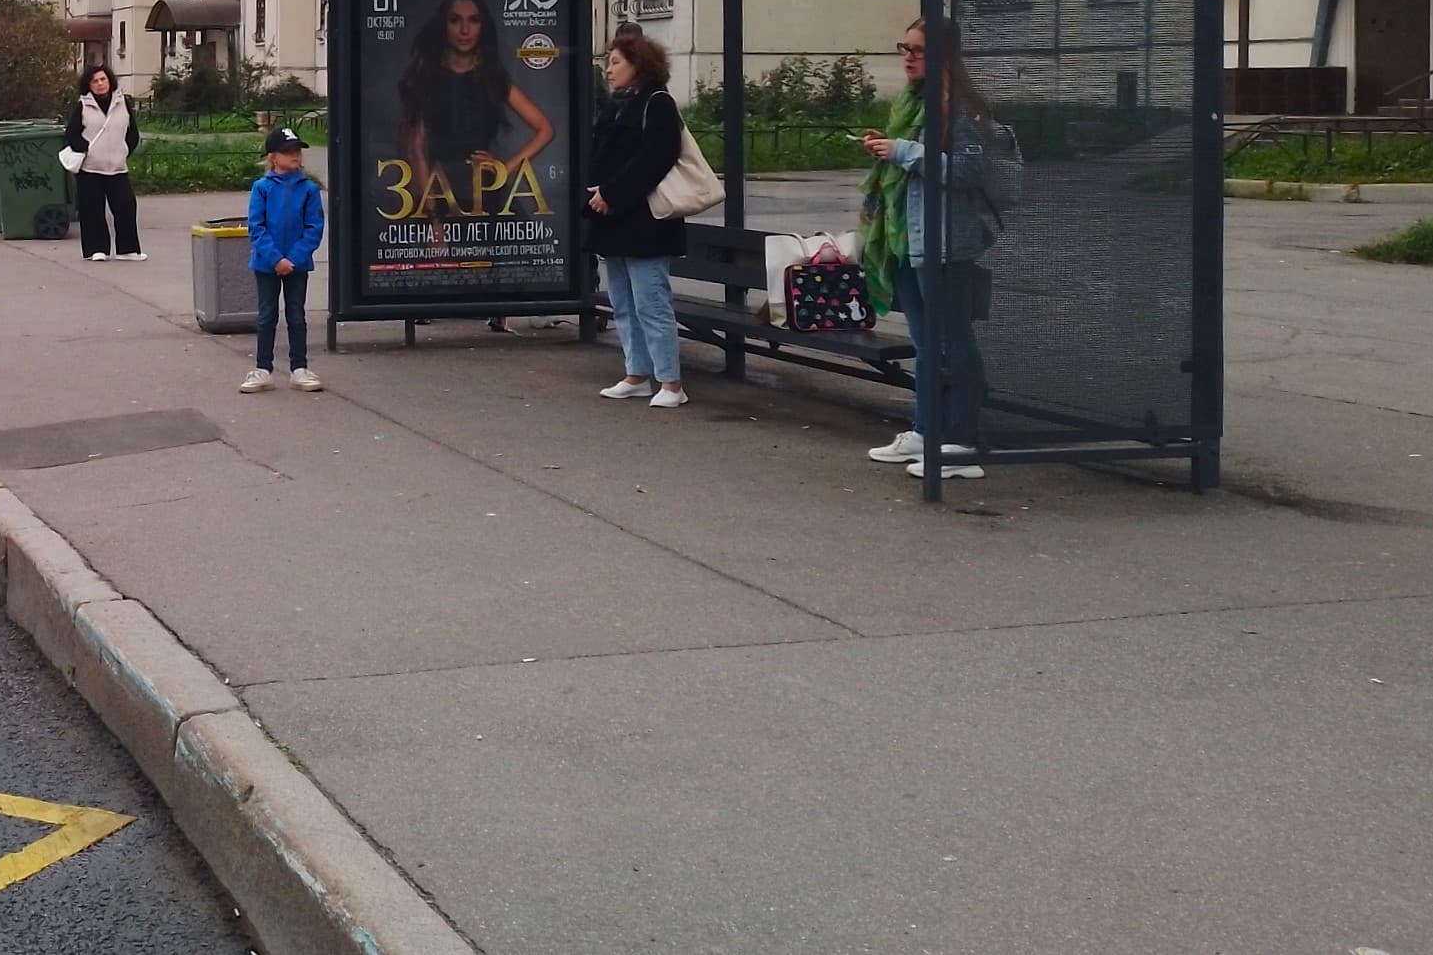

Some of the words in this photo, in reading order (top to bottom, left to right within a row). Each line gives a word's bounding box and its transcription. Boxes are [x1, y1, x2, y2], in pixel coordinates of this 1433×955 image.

[367, 16, 405, 28] ОКТЯБРЯ
[375, 157, 555, 220] ЗАРА
[378, 224, 440, 244] «СЦЕНА:
[443, 223, 461, 242] 30
[466, 222, 490, 242] ЛЕТ
[494, 220, 553, 241] ЛЮБВИ»
[377, 248, 383, 259] В
[451, 245, 519, 257] СИМФОНИЧЕСКОГО
[519, 244, 556, 256] ОРКЕСТРА
